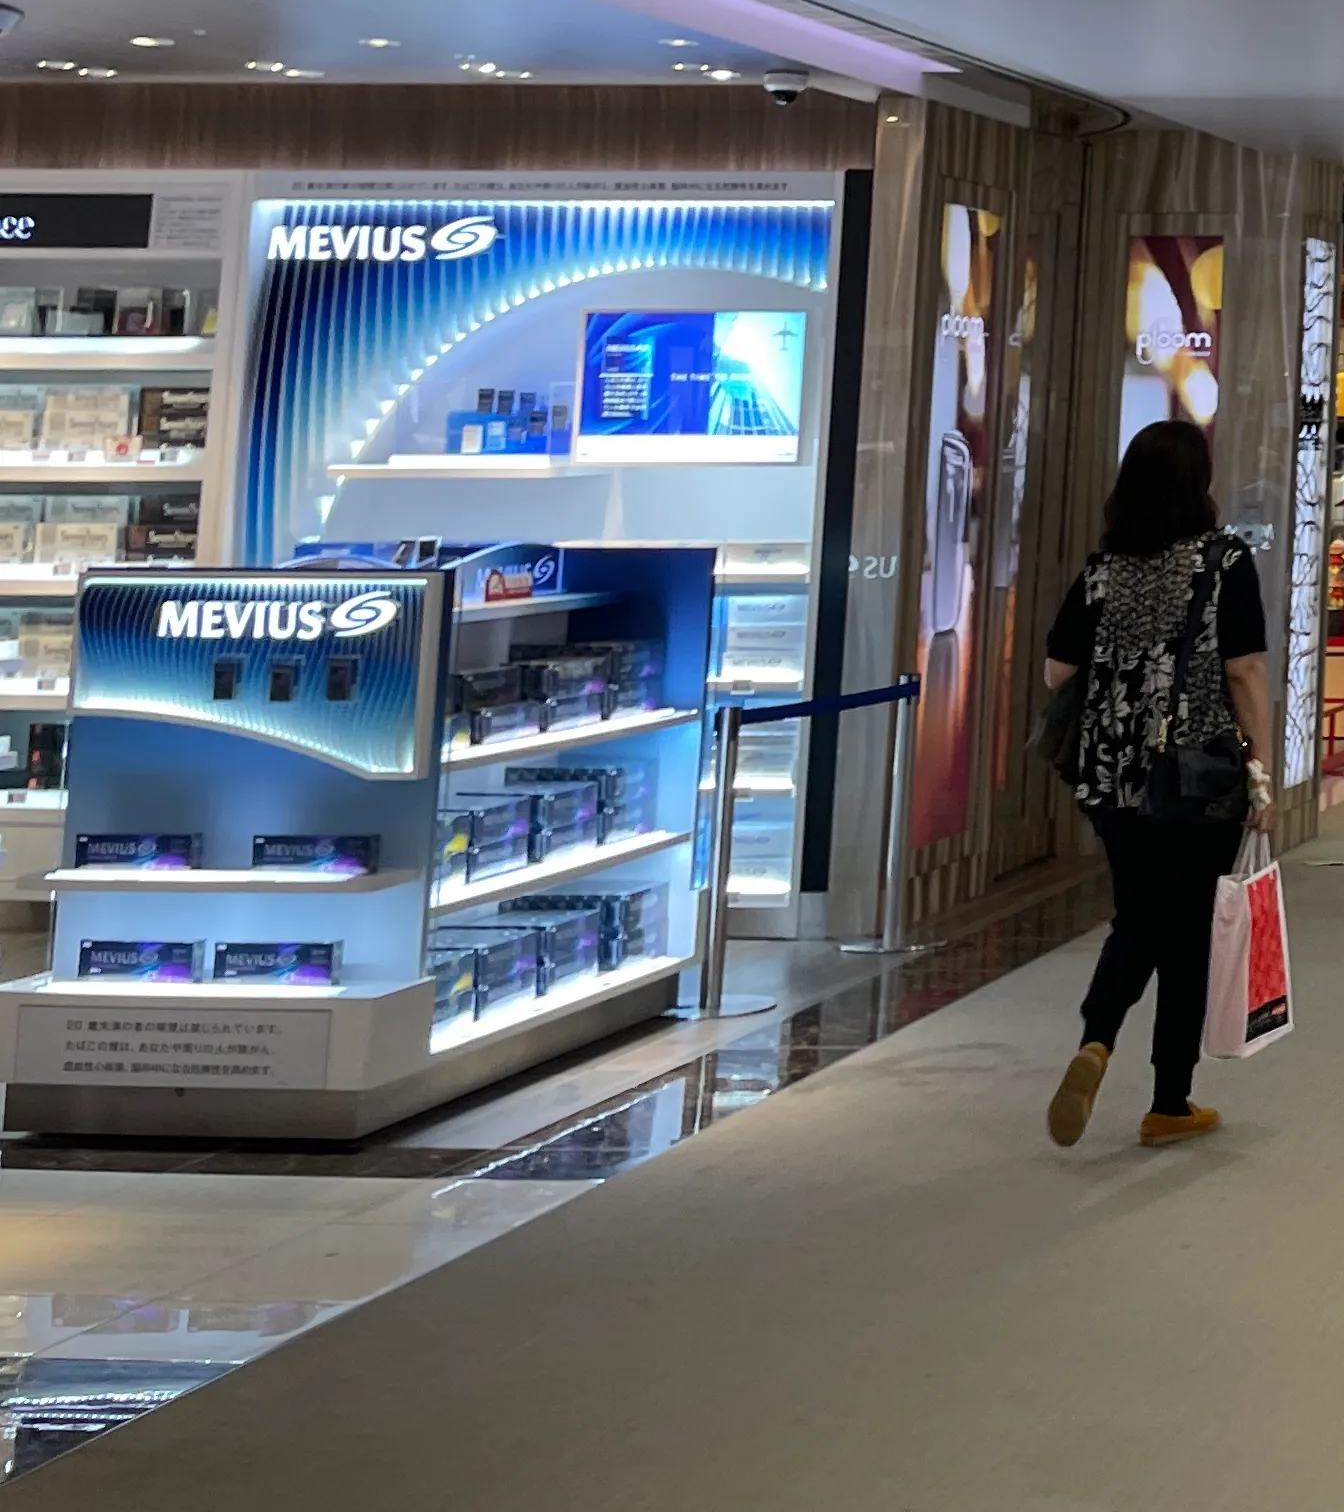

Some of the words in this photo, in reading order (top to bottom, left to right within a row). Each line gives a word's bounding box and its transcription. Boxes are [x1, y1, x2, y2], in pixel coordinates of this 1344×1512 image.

[267, 224, 428, 262] MEVIUS
[1136, 319, 1212, 364] ploom
[157, 600, 323, 640] MEVIUS
